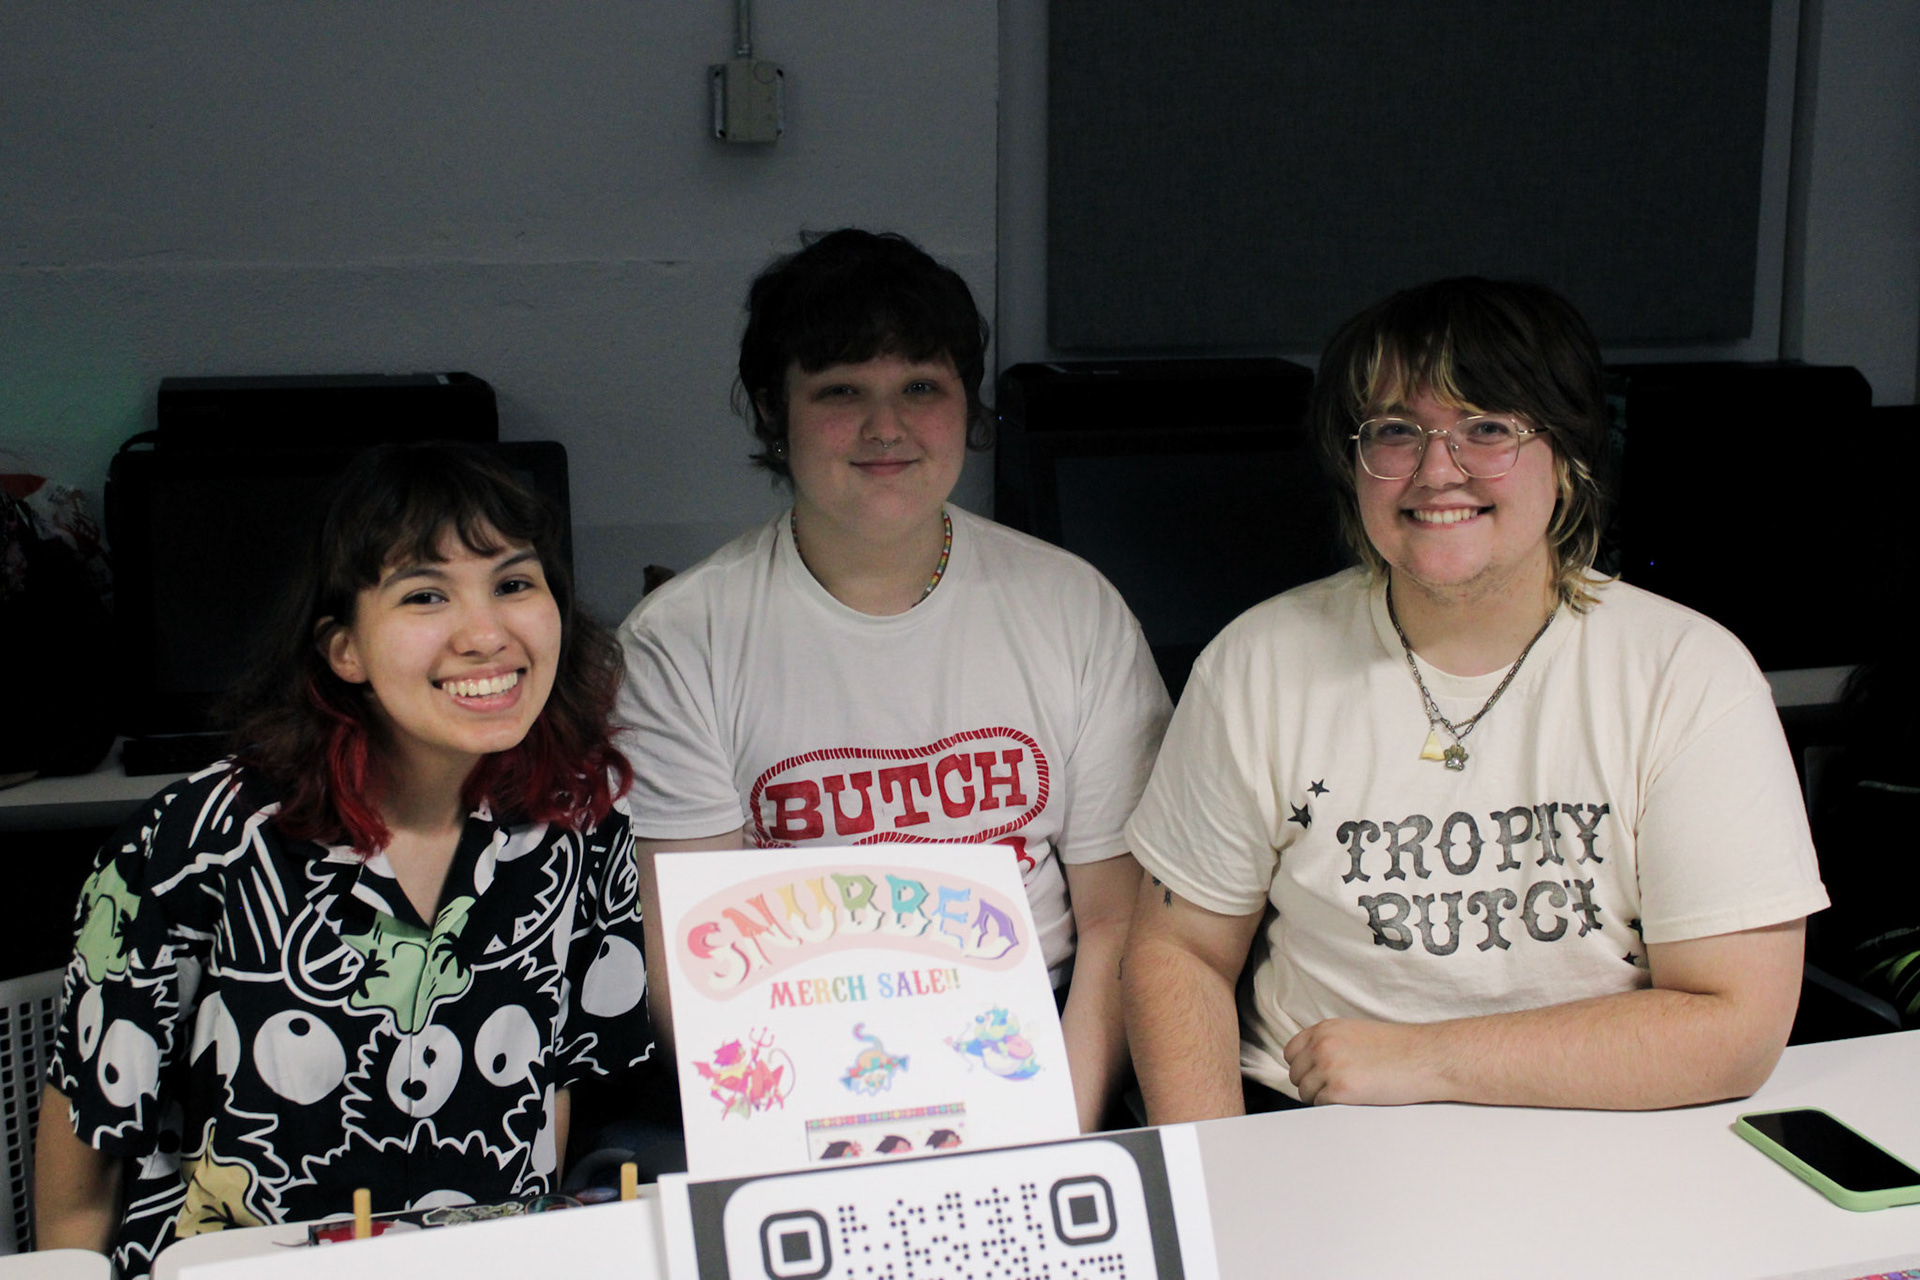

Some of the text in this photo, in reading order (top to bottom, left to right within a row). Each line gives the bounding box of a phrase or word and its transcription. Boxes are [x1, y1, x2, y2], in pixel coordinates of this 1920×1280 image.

[764, 748, 1027, 841] BUTCH
[687, 872, 1020, 991] SNUBBED
[769, 967, 962, 1009] MERCH SALE!!
